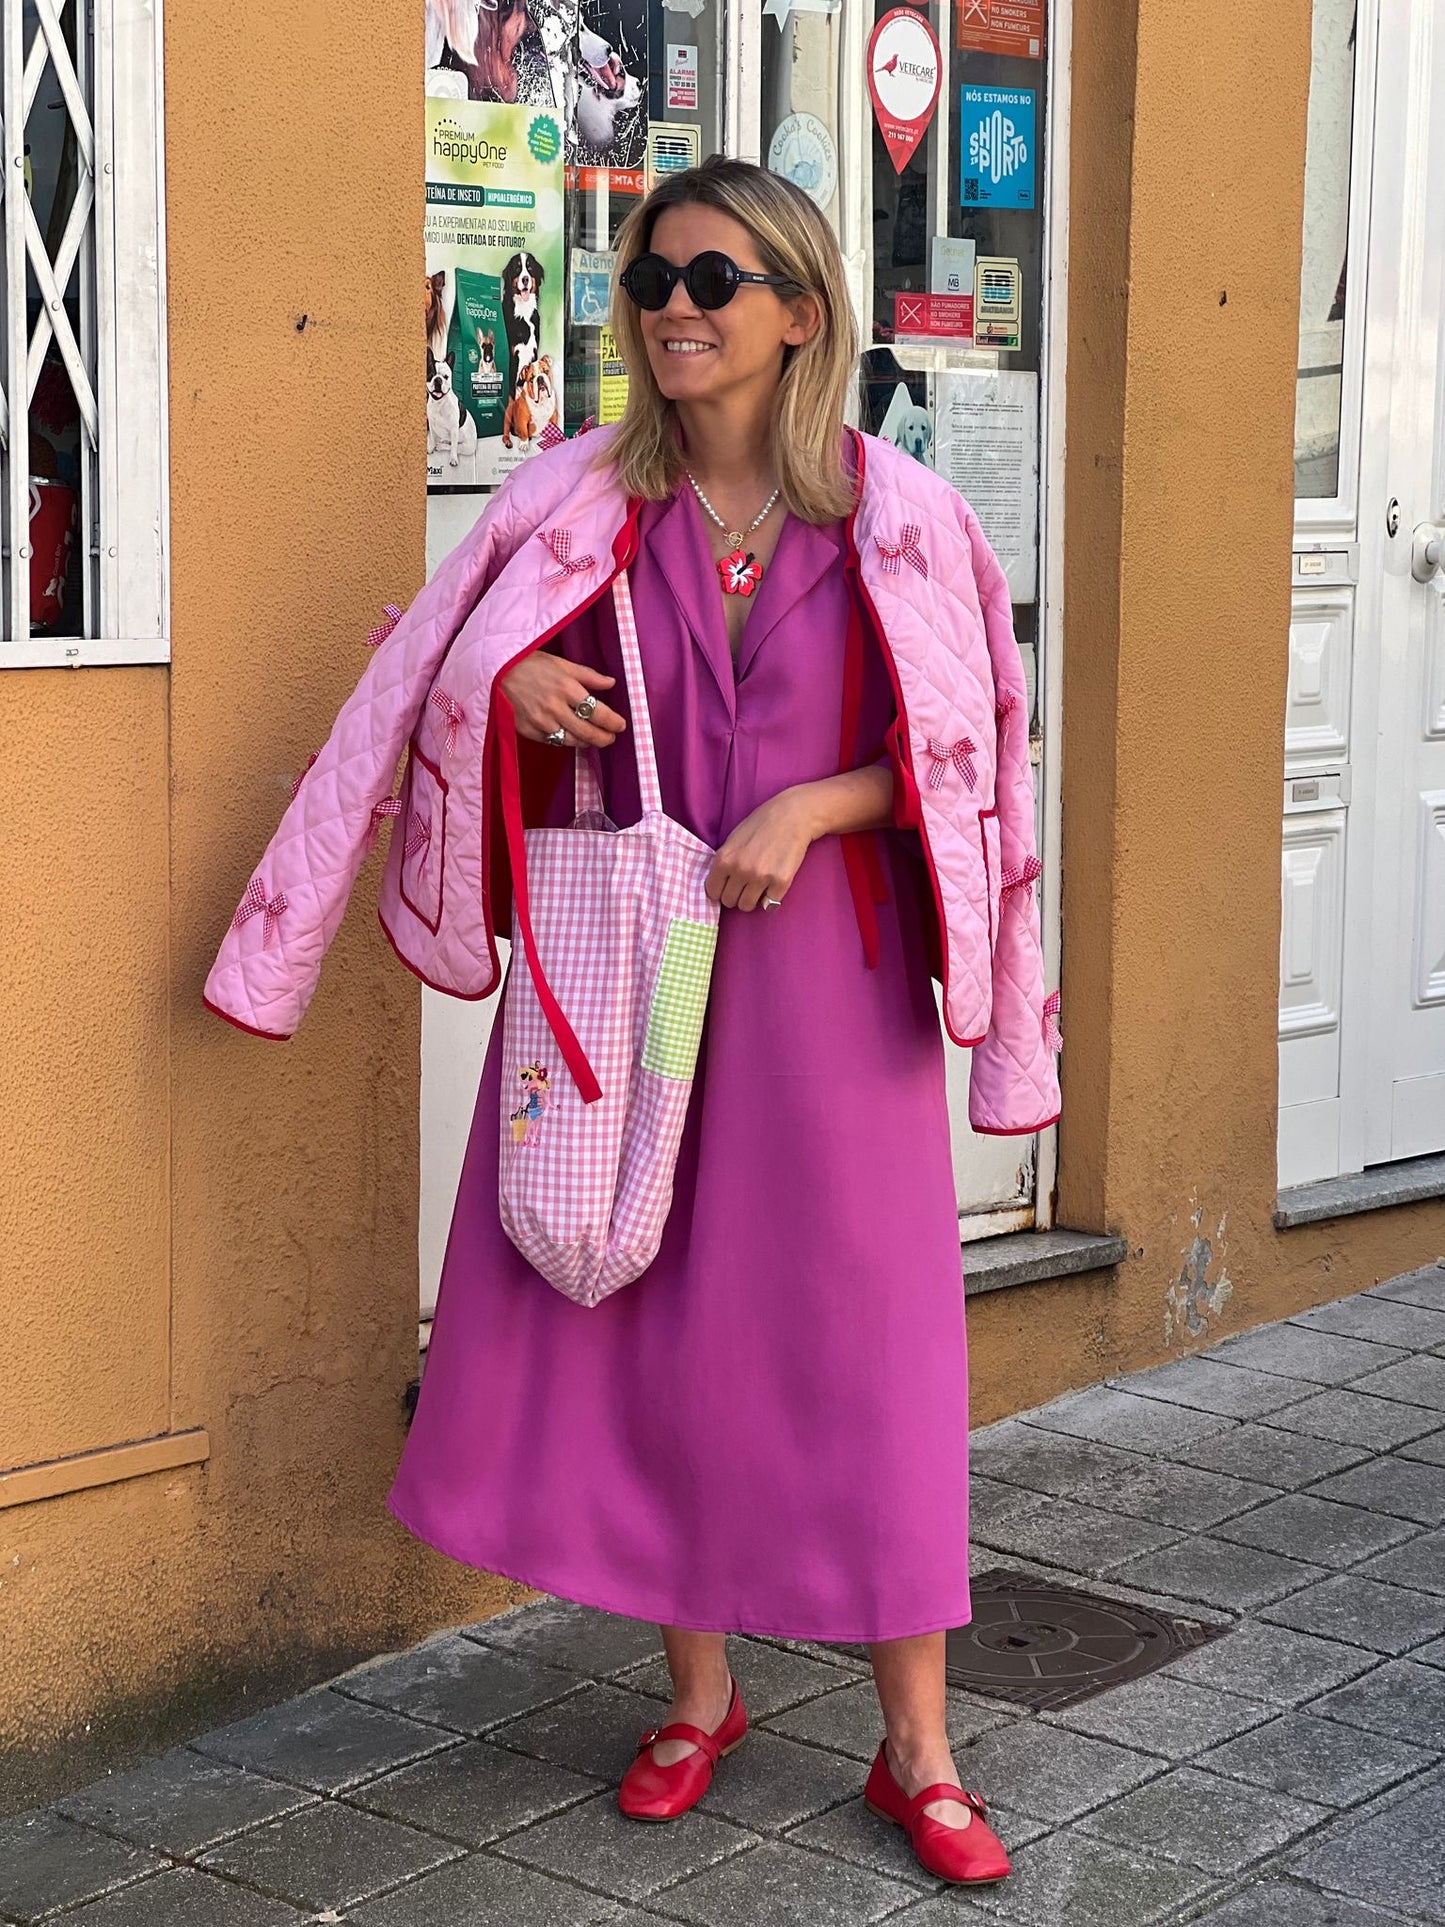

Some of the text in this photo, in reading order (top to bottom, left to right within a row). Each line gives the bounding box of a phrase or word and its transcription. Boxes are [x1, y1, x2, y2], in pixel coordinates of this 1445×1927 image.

[992, 6, 1027, 18] NO SMOKERS
[991, 19, 1030, 32] NON FUMEURS
[899, 61, 934, 78] VETECARE
[966, 90, 1032, 105] NÓS ESTAMOS NO
[438, 129, 475, 141] PREMIUM
[806, 119, 832, 162] Cookies
[433, 137, 508, 164] happyOne
[492, 162, 505, 170] FOOD
[447, 188, 456, 201] DE
[457, 189, 481, 203] INSETO
[488, 192, 533, 205] HIPOALERGÉNICO
[432, 216, 438, 228] A
[438, 216, 487, 230] EXPERIMENTAR
[487, 220, 497, 231] AO
[498, 220, 510, 232] SEU
[511, 221, 536, 233] MELHOR
[441, 233, 456, 244] UMA
[457, 232, 487, 247] DENTADA
[488, 235, 497, 247] DE
[498, 236, 526, 248] FUTURO?
[465, 305, 498, 320] happyOne
[930, 300, 970, 310] NÃO FUMADORES
